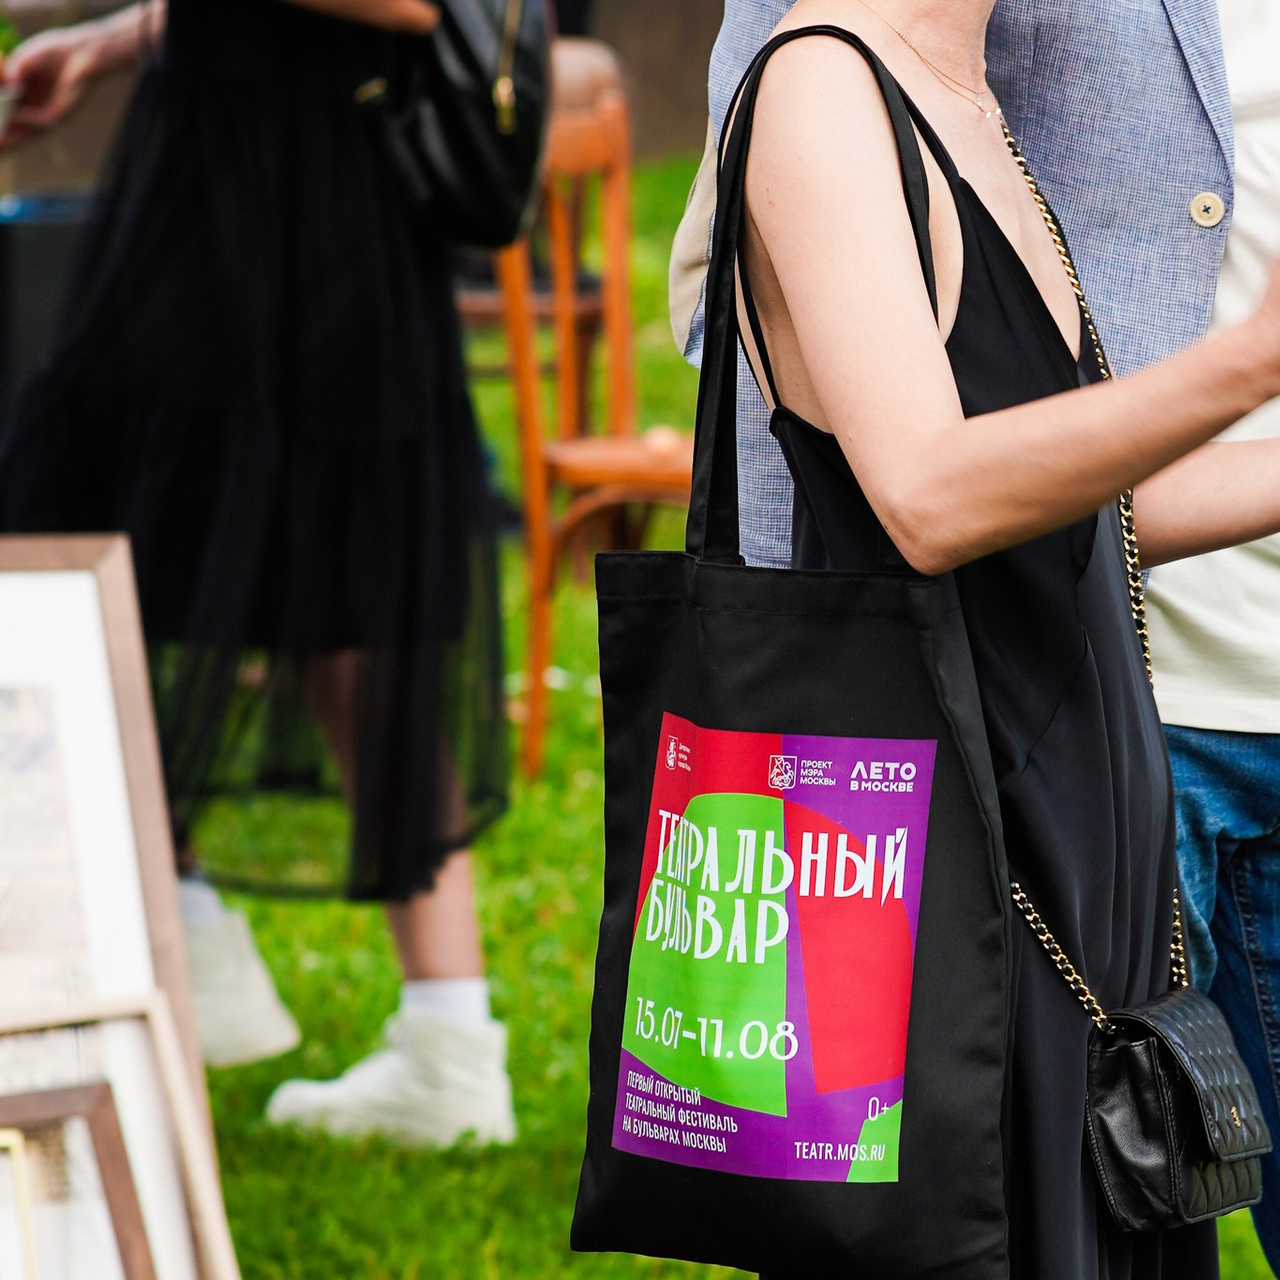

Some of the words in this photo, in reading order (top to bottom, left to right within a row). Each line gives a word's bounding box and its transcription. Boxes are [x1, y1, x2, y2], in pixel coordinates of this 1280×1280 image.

[800, 759, 833, 769] ПРОЕКТ
[800, 768, 824, 777] МЭРА
[850, 761, 917, 780] ЛЕТО
[800, 776, 836, 786] МОСКВЫ
[850, 781, 858, 791] В
[861, 781, 914, 793] МОСКВЕ
[657, 809, 908, 908] ТЕАТРАЛЬНЫЙ
[645, 877, 790, 964] БУЛЬВАР
[627, 1070, 654, 1094] ПЕРВЫЙ
[655, 1080, 702, 1106] ОТКРЫТЫЙ
[625, 1092, 676, 1123] ТЕАТРАЛЬНЫЙ
[678, 1107, 739, 1133] ФЕСТИВАЛЬ
[867, 1096, 890, 1122] 0+
[622, 1114, 632, 1133] НА
[633, 1118, 681, 1145] БУЛЬВАРАХ
[682, 1130, 727, 1153] МОСКВЫ
[794, 1141, 886, 1162] TEATR.MOS.RU
